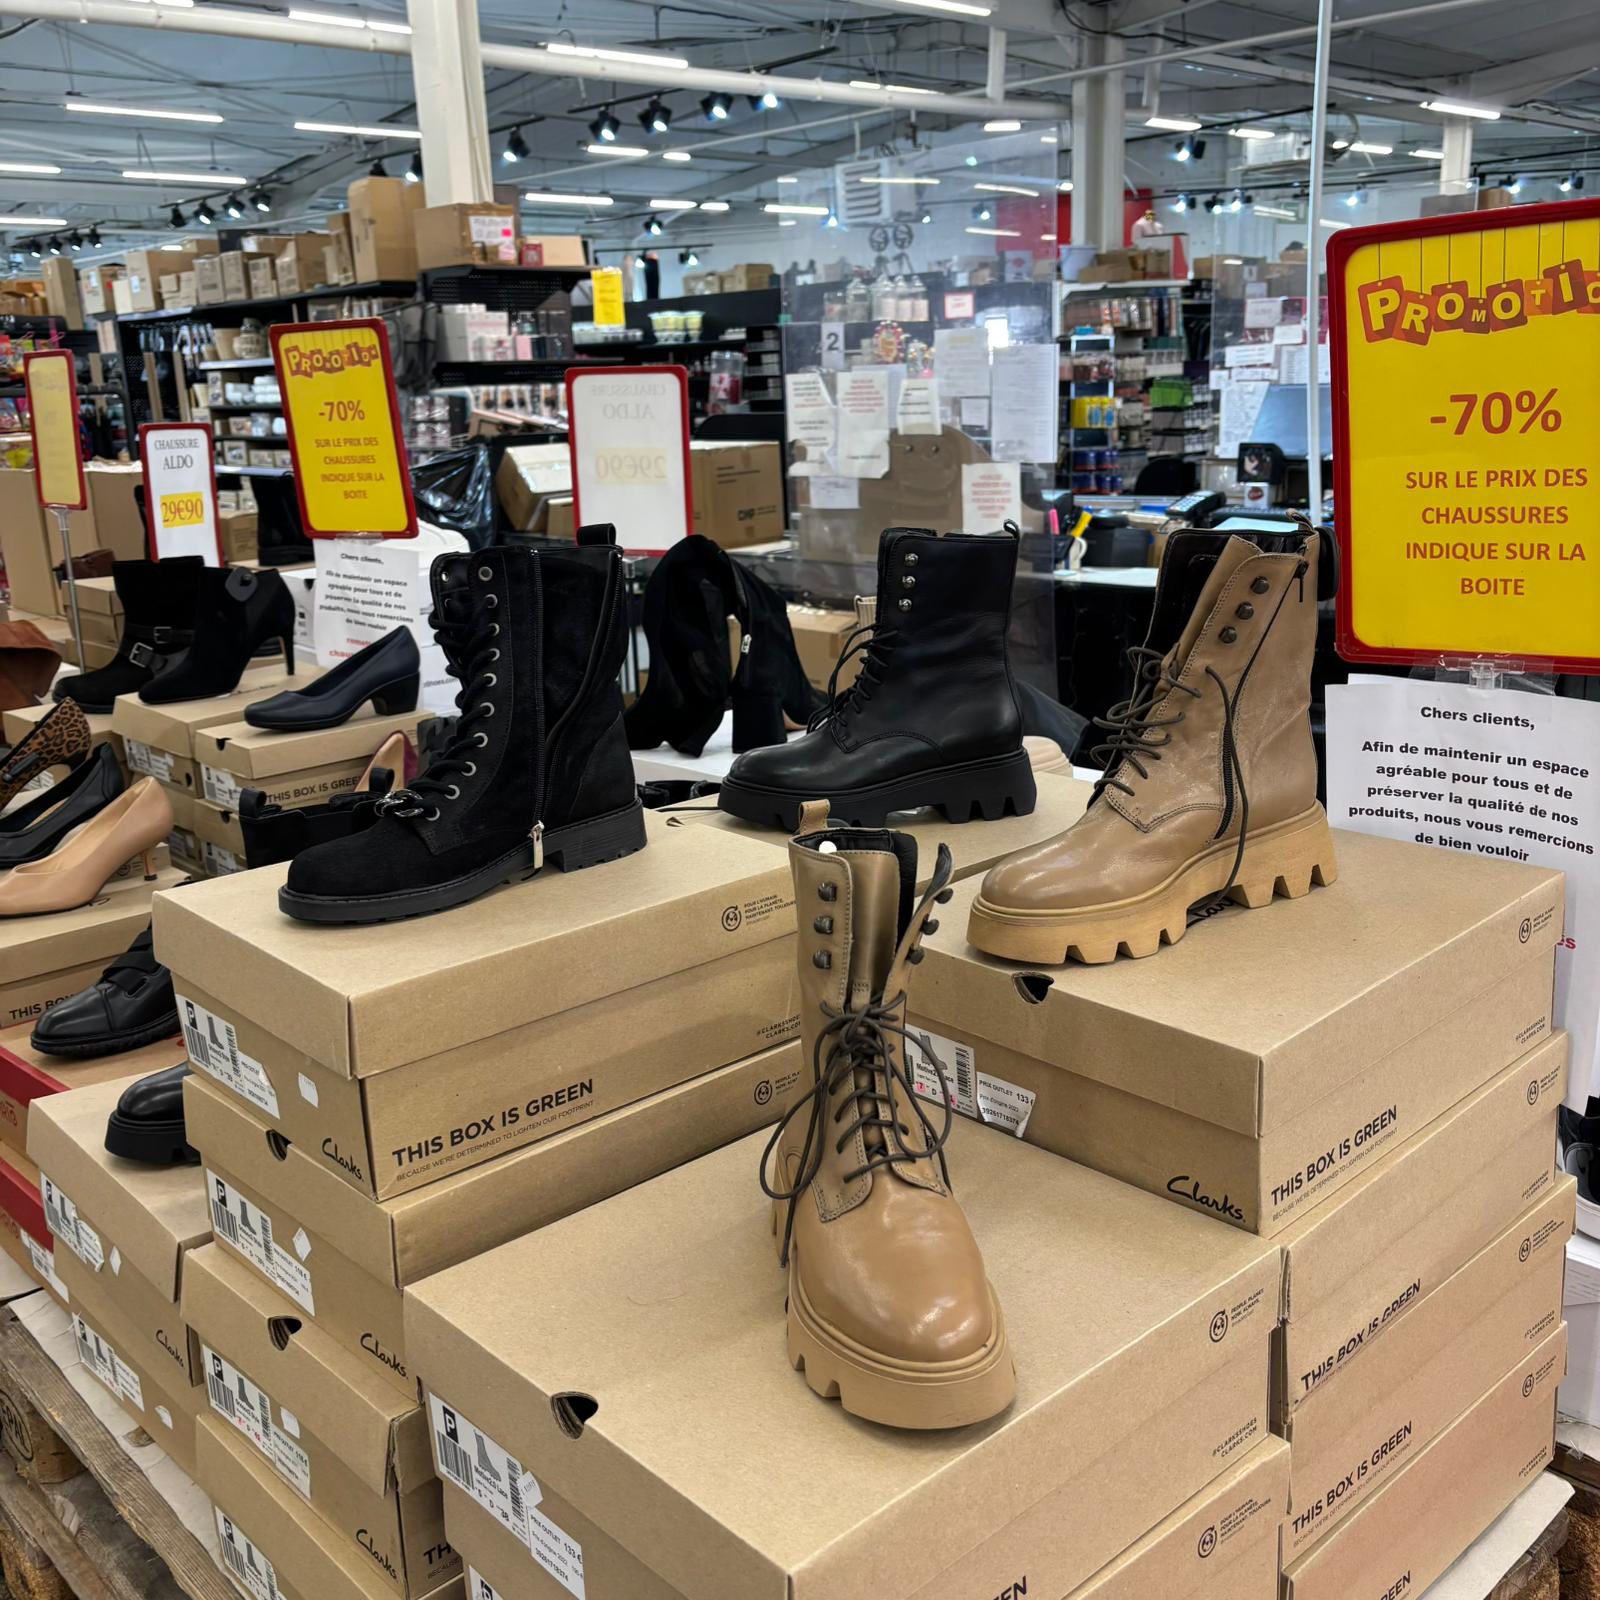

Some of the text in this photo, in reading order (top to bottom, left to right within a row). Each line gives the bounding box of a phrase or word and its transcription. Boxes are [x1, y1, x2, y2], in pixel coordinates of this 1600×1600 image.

[826, 332, 839, 351] 2
[318, 400, 365, 421] -70%
[1430, 388, 1562, 435] -70%
[314, 437, 379, 448] SUR LE PRIX DES
[163, 454, 194, 470] ALDO
[323, 455, 376, 465] CHAUSSURES
[321, 471, 385, 483] INDIQUE SUR LA
[1406, 468, 1588, 489] SUR LE PRIX DES
[343, 489, 368, 499] BOITE
[161, 498, 204, 523] 29€90
[1421, 505, 1569, 524] CHAUSSURES
[1406, 542, 1586, 562] INDIQUE SUR LA
[1460, 578, 1525, 595] BOITE
[1420, 706, 1536, 730] Chers clients,
[1362, 740, 1589, 779] Afin de maintenir un espace
[1376, 763, 1573, 800] agréable pour tous et de
[267, 790, 291, 803] THIS
[293, 787, 317, 798] BOX
[318, 782, 329, 791] IS
[1367, 785, 1579, 826] préserver la qualité de nos
[1348, 804, 1595, 855] produits, nous vous remercions
[1414, 832, 1530, 862] de bien vouloir
[9, 1003, 42, 1020] THIS
[992, 1083, 1014, 1097] OUTLET
[1016, 1092, 1030, 1105] 133
[392, 1078, 593, 1167] THIS BOX IS GREEN
[396, 1163, 431, 1182] BECAUSE
[456, 1137, 501, 1161] DETERMINED
[502, 1131, 513, 1141] TO
[513, 1120, 542, 1138] LIGHTEN
[542, 1115, 558, 1125] OUR
[558, 1100, 594, 1119] FOOTPRINT
[1271, 1104, 1397, 1206] THIS BOX IS GREEN
[217, 1183, 225, 1200] P
[1301, 1355, 1334, 1391] THIS
[1336, 1328, 1365, 1363] BOX
[1367, 1317, 1379, 1336] IS
[1381, 1278, 1421, 1323] GREEN
[213, 1359, 222, 1373] P
[443, 1411, 456, 1434] P
[1220, 1425, 1258, 1458] CLARKS.COM
[1292, 1420, 1413, 1535] THIS BOX IS GREEN
[563, 1542, 576, 1559] 133
